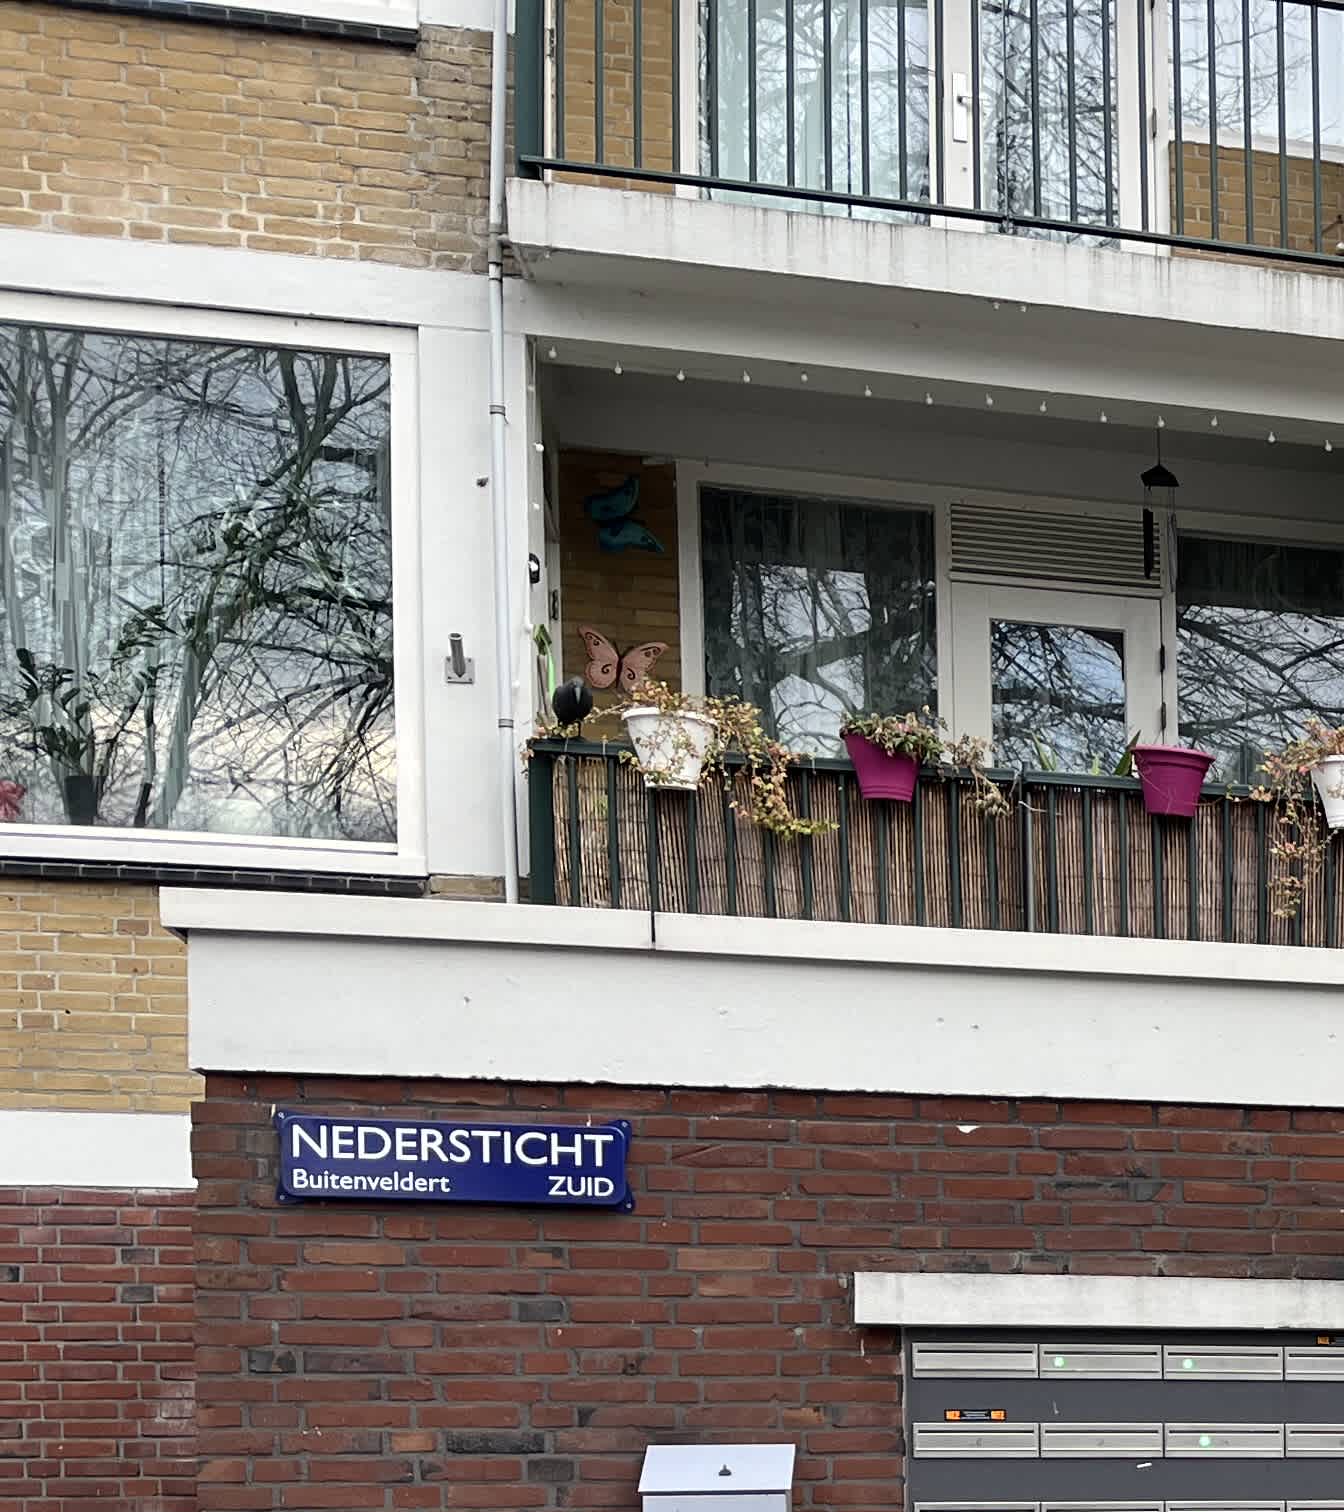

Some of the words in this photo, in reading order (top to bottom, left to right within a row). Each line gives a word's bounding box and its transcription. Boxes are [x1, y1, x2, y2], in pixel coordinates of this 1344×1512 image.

[291, 1124, 615, 1168] NEDERSTICHT
[291, 1168, 451, 1194] Buitenveldert
[547, 1175, 615, 1198] ZUID
